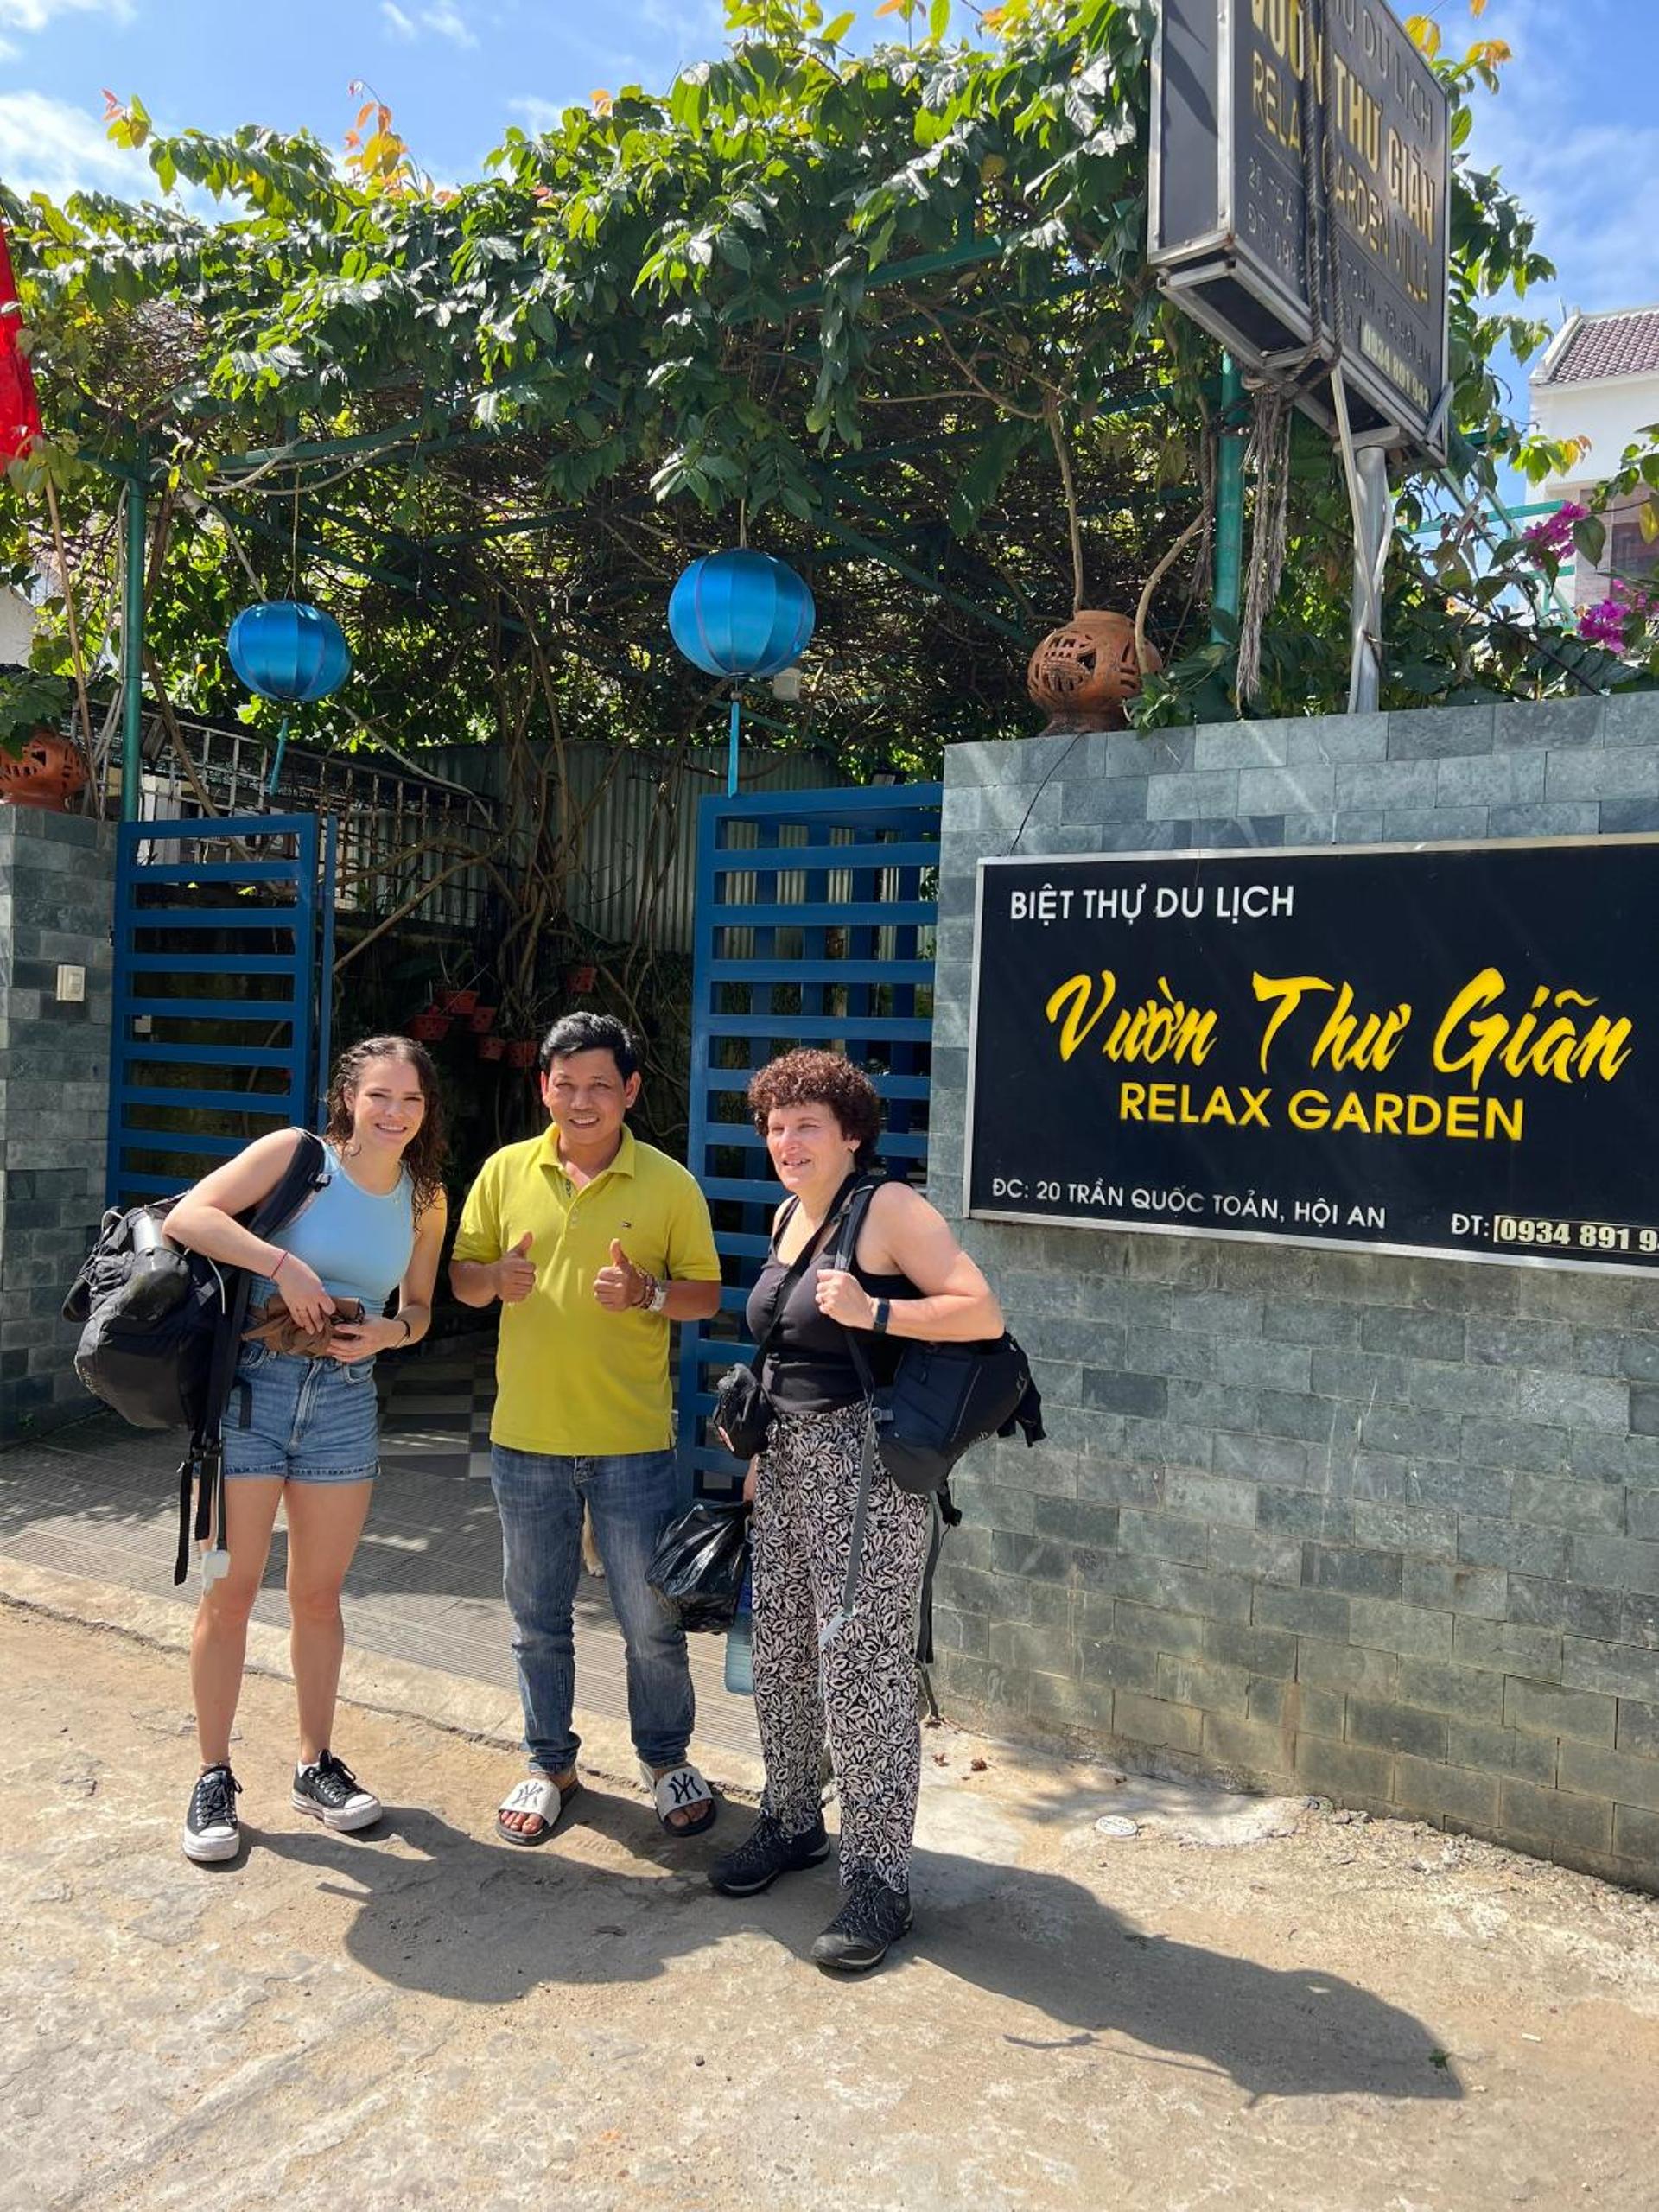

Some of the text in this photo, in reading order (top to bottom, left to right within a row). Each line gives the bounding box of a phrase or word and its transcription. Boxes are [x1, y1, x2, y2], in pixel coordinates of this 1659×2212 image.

[1333, 51, 1383, 174] THƯ
[1388, 126, 1435, 247] GIÃN
[1253, 50, 1308, 164] RELA
[1395, 219, 1431, 308] VILLA
[1393, 355, 1410, 395] 891
[1010, 883, 1294, 926] BIỆT THỰ DU LỊCH
[1046, 966, 1633, 1092] Vườn Thư Giãn
[1120, 1082, 1524, 1141] RELAX GARDEN
[992, 1177, 1387, 1230] ĐC: 20 TRẦN QUỐC TOẢN, HỘI AN
[1451, 1212, 1659, 1253] ĐT: 0934 891 9
